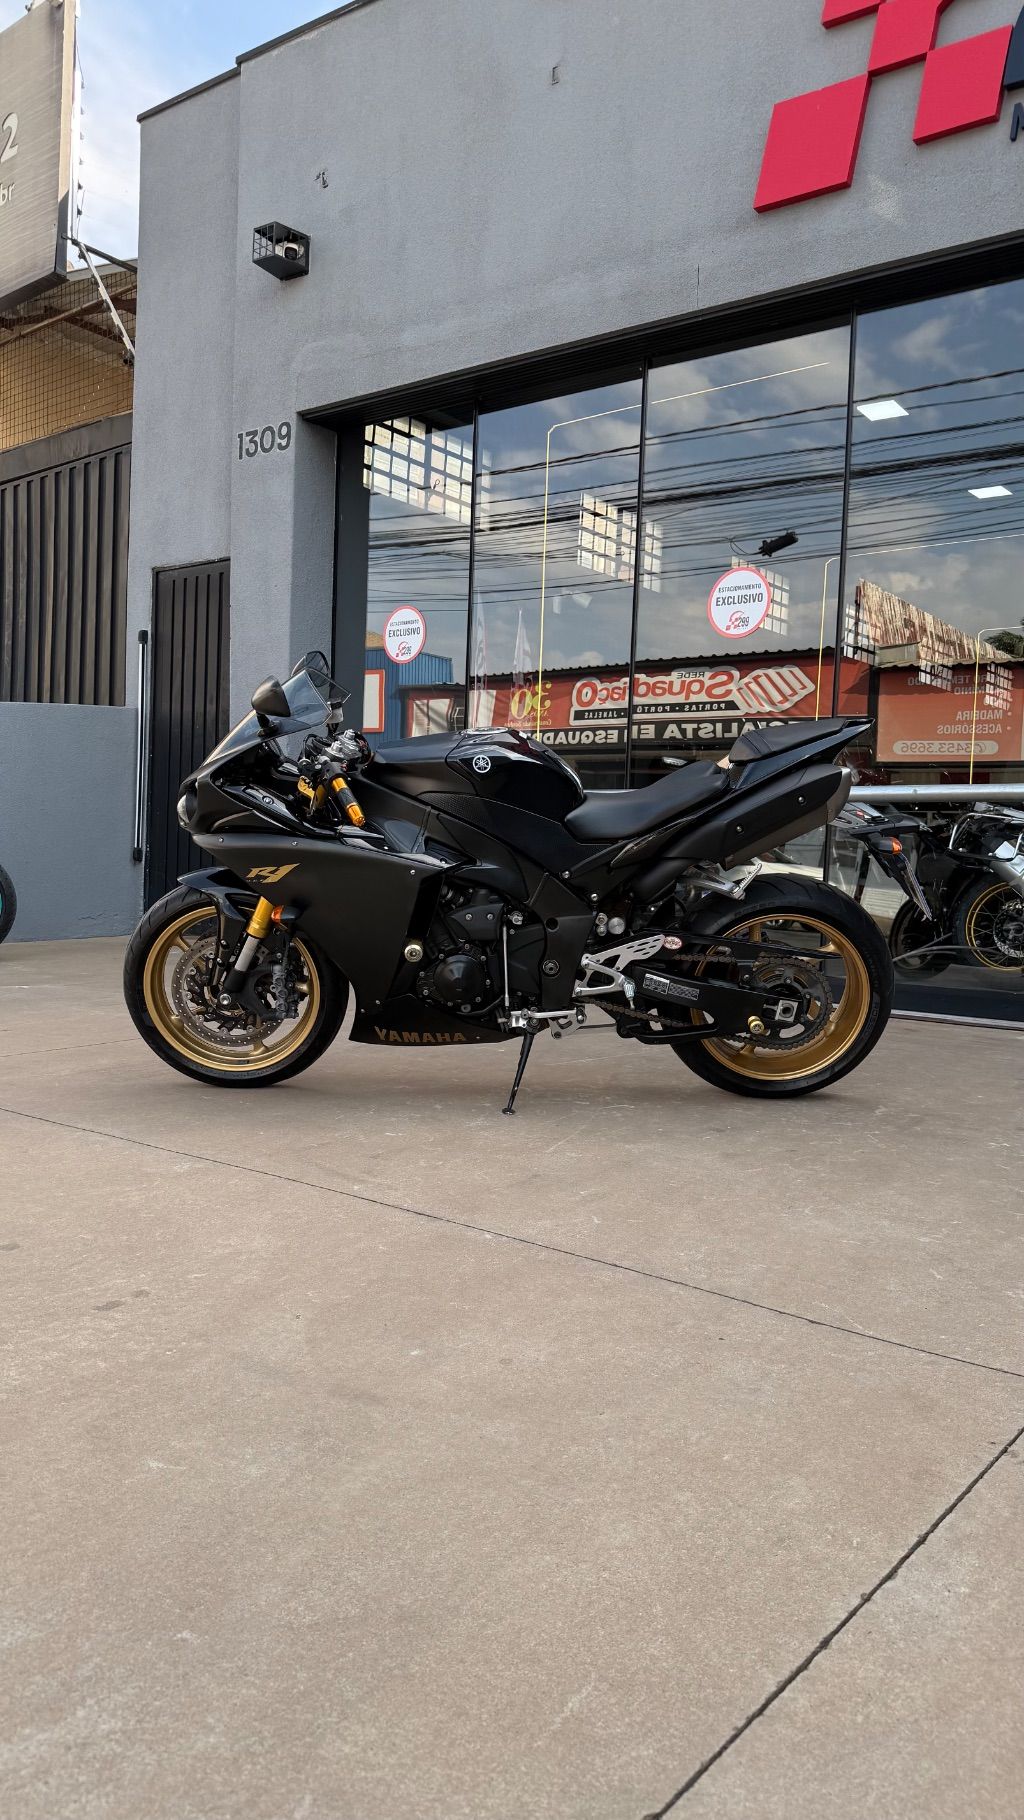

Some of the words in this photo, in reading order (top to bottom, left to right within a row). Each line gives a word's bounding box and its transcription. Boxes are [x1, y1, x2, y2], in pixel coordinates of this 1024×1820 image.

[237, 421, 292, 460] 1309
[715, 592, 764, 607] EXCLUSIVO
[388, 626, 421, 638] EXCLUSIVO
[245, 862, 301, 883] R1
[373, 1025, 467, 1043] YAMAHA
